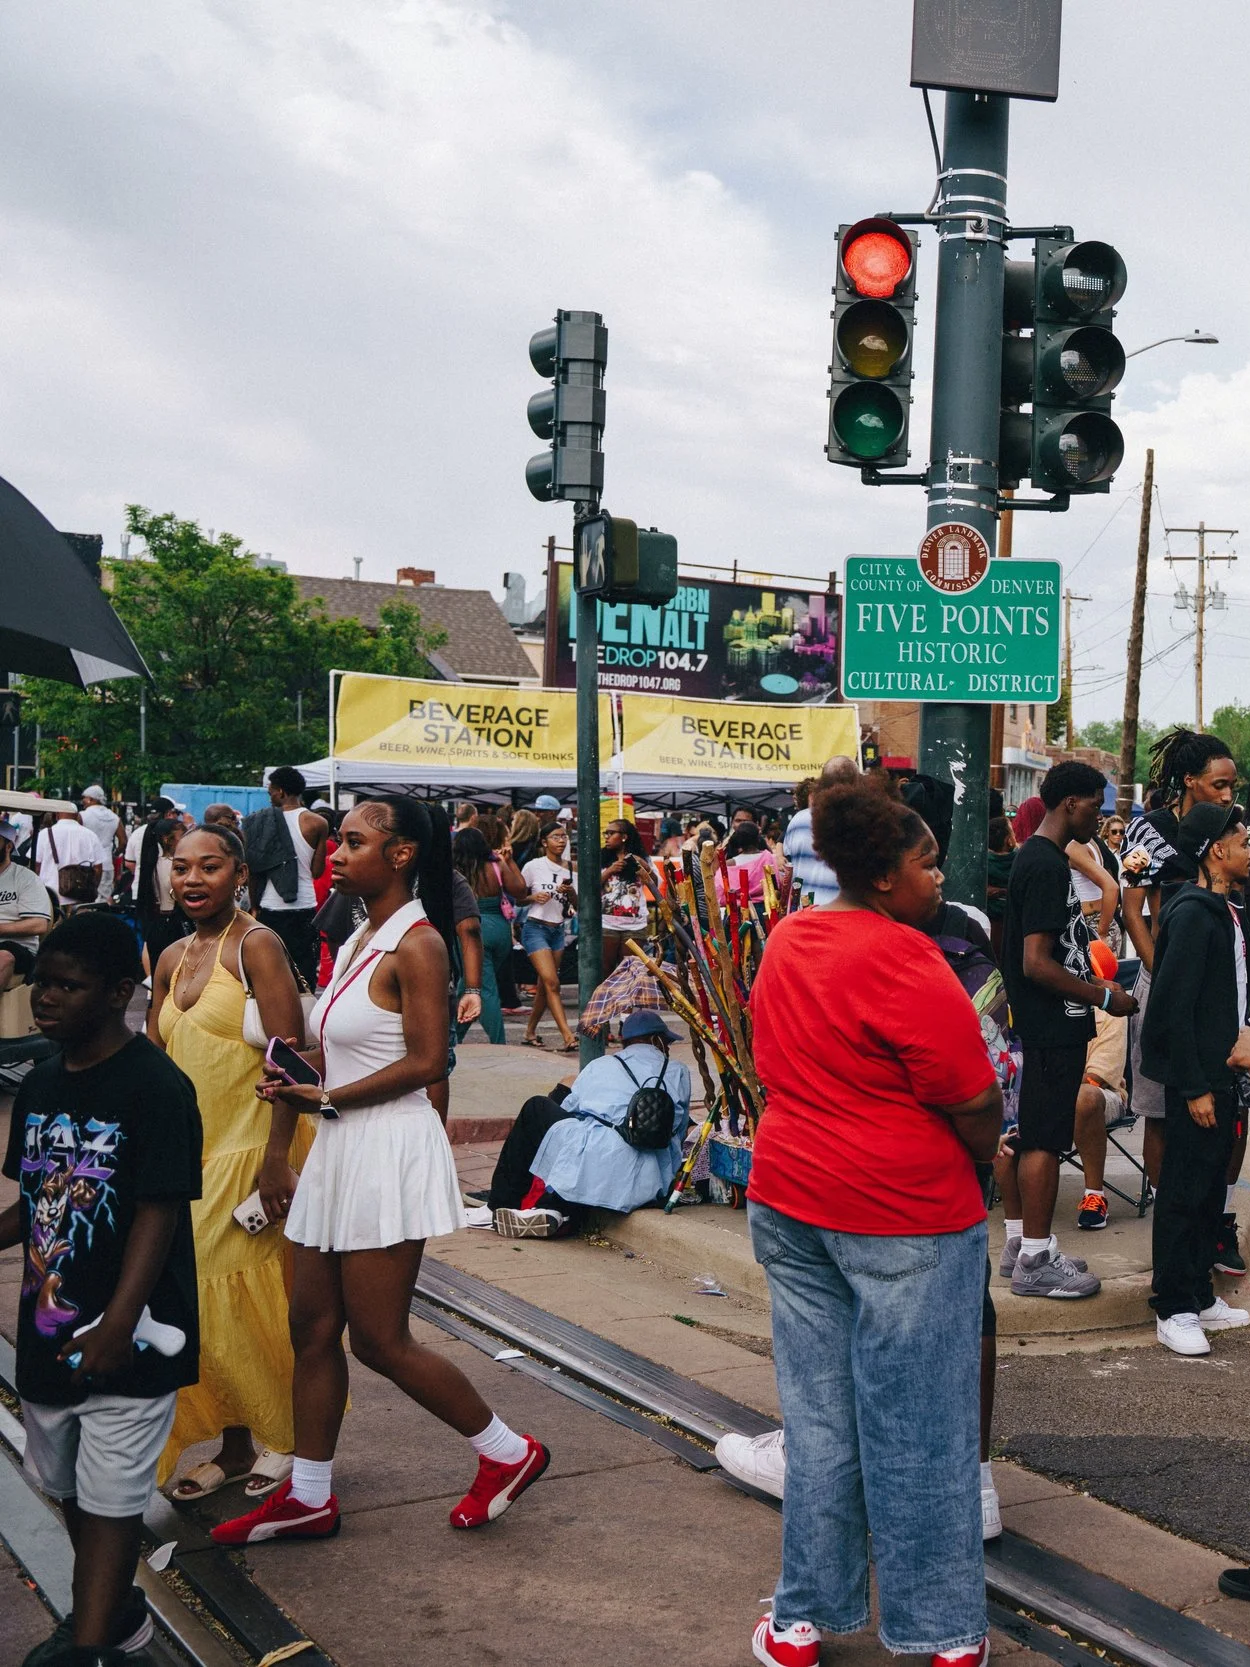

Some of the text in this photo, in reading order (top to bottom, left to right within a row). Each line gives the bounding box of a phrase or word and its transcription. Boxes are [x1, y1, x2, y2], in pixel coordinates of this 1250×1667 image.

[921, 526, 987, 559] DENVER LANDMARK
[859, 563, 906, 576] CITY &
[925, 569, 982, 591] COMMISSION
[850, 579, 1055, 595] COUNTY OF DENVER
[856, 603, 1049, 636] FIVE POINTS
[898, 641, 1007, 664] HISTORIC
[847, 671, 1055, 693] CULTURAL DISTRICT
[409, 699, 549, 727] BEVERAGE
[424, 724, 533, 748] STATION
[681, 716, 803, 740] BEVERAGE
[379, 742, 411, 754] BEER,
[416, 745, 447, 756] WINE,
[449, 747, 489, 758] SPIRITS
[502, 750, 530, 760] SOFT
[532, 752, 574, 761] DRINKS
[693, 738, 791, 760] STATION
[659, 755, 824, 771] BEER, WINE, SPIRITS & SOFT DRINK
